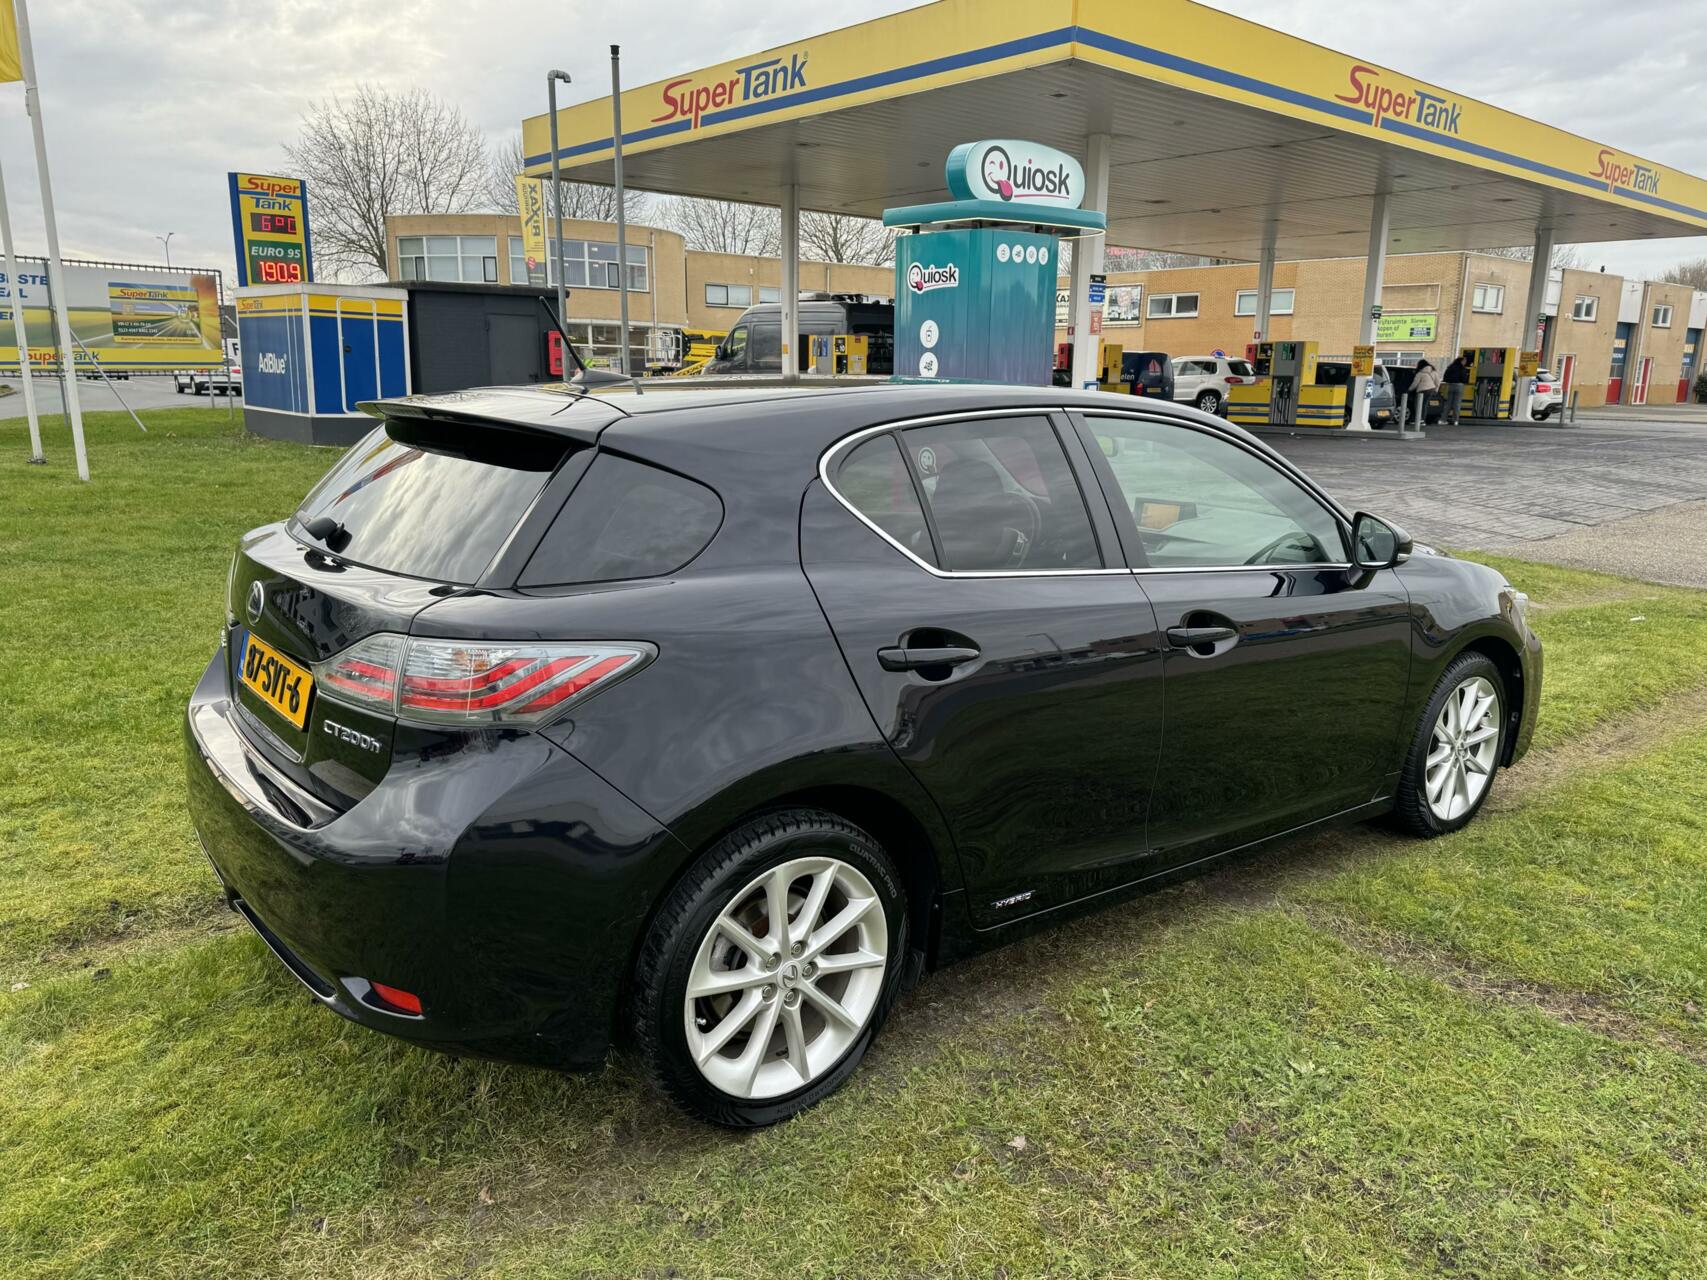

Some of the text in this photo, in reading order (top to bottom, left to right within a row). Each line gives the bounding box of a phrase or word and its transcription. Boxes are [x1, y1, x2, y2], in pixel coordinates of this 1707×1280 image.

[651, 54, 808, 129] SuperTank
[1334, 65, 1461, 134] SuperTank
[981, 145, 1070, 201] Quiosk
[240, 177, 299, 197] Super
[250, 197, 292, 211] Tank
[251, 246, 302, 258] EURO 95
[260, 261, 302, 283] 190.9
[909, 265, 957, 291] Quiosk
[258, 352, 287, 374] AdBlue
[246, 643, 302, 714] 87-SVT-6
[323, 719, 382, 753] CT200h
